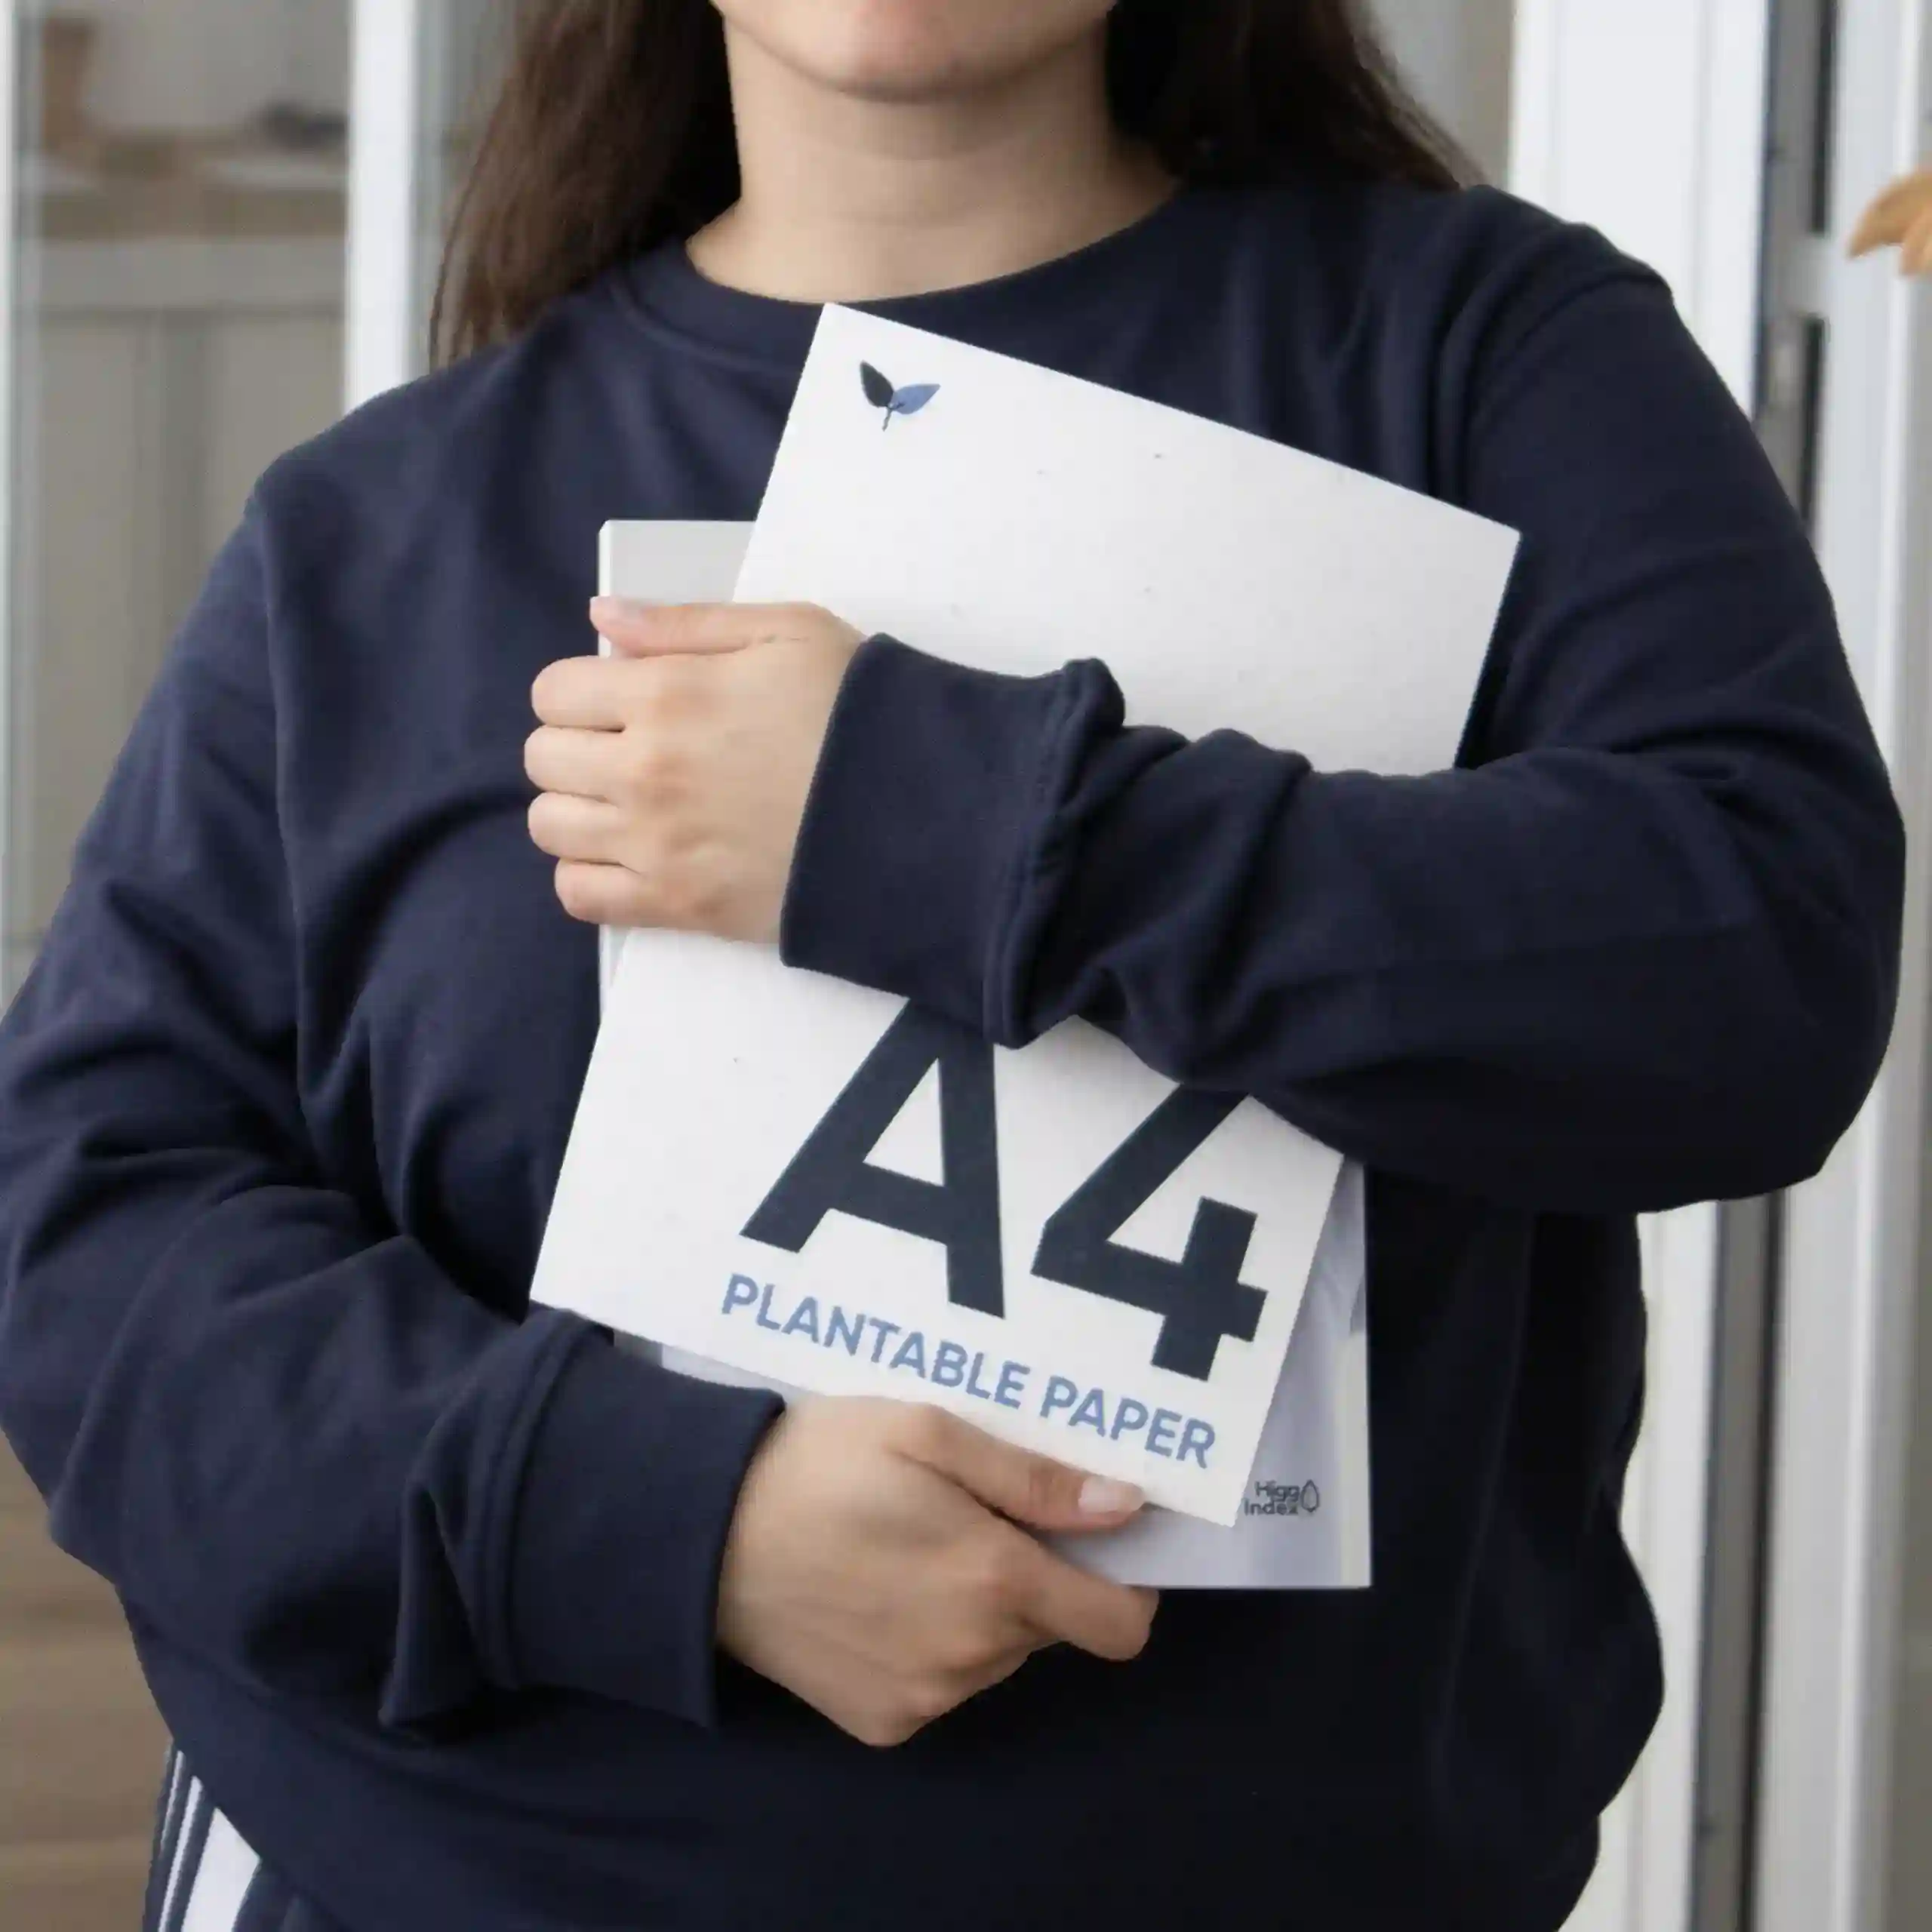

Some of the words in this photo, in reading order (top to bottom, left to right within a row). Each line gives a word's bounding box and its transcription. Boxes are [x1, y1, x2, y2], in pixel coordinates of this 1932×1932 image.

[739, 998, 1269, 1382] A4
[721, 1273, 1031, 1410] PLANTABLE
[1039, 1374, 1217, 1469] PAPER
[1254, 1480, 1300, 1502] Higg
